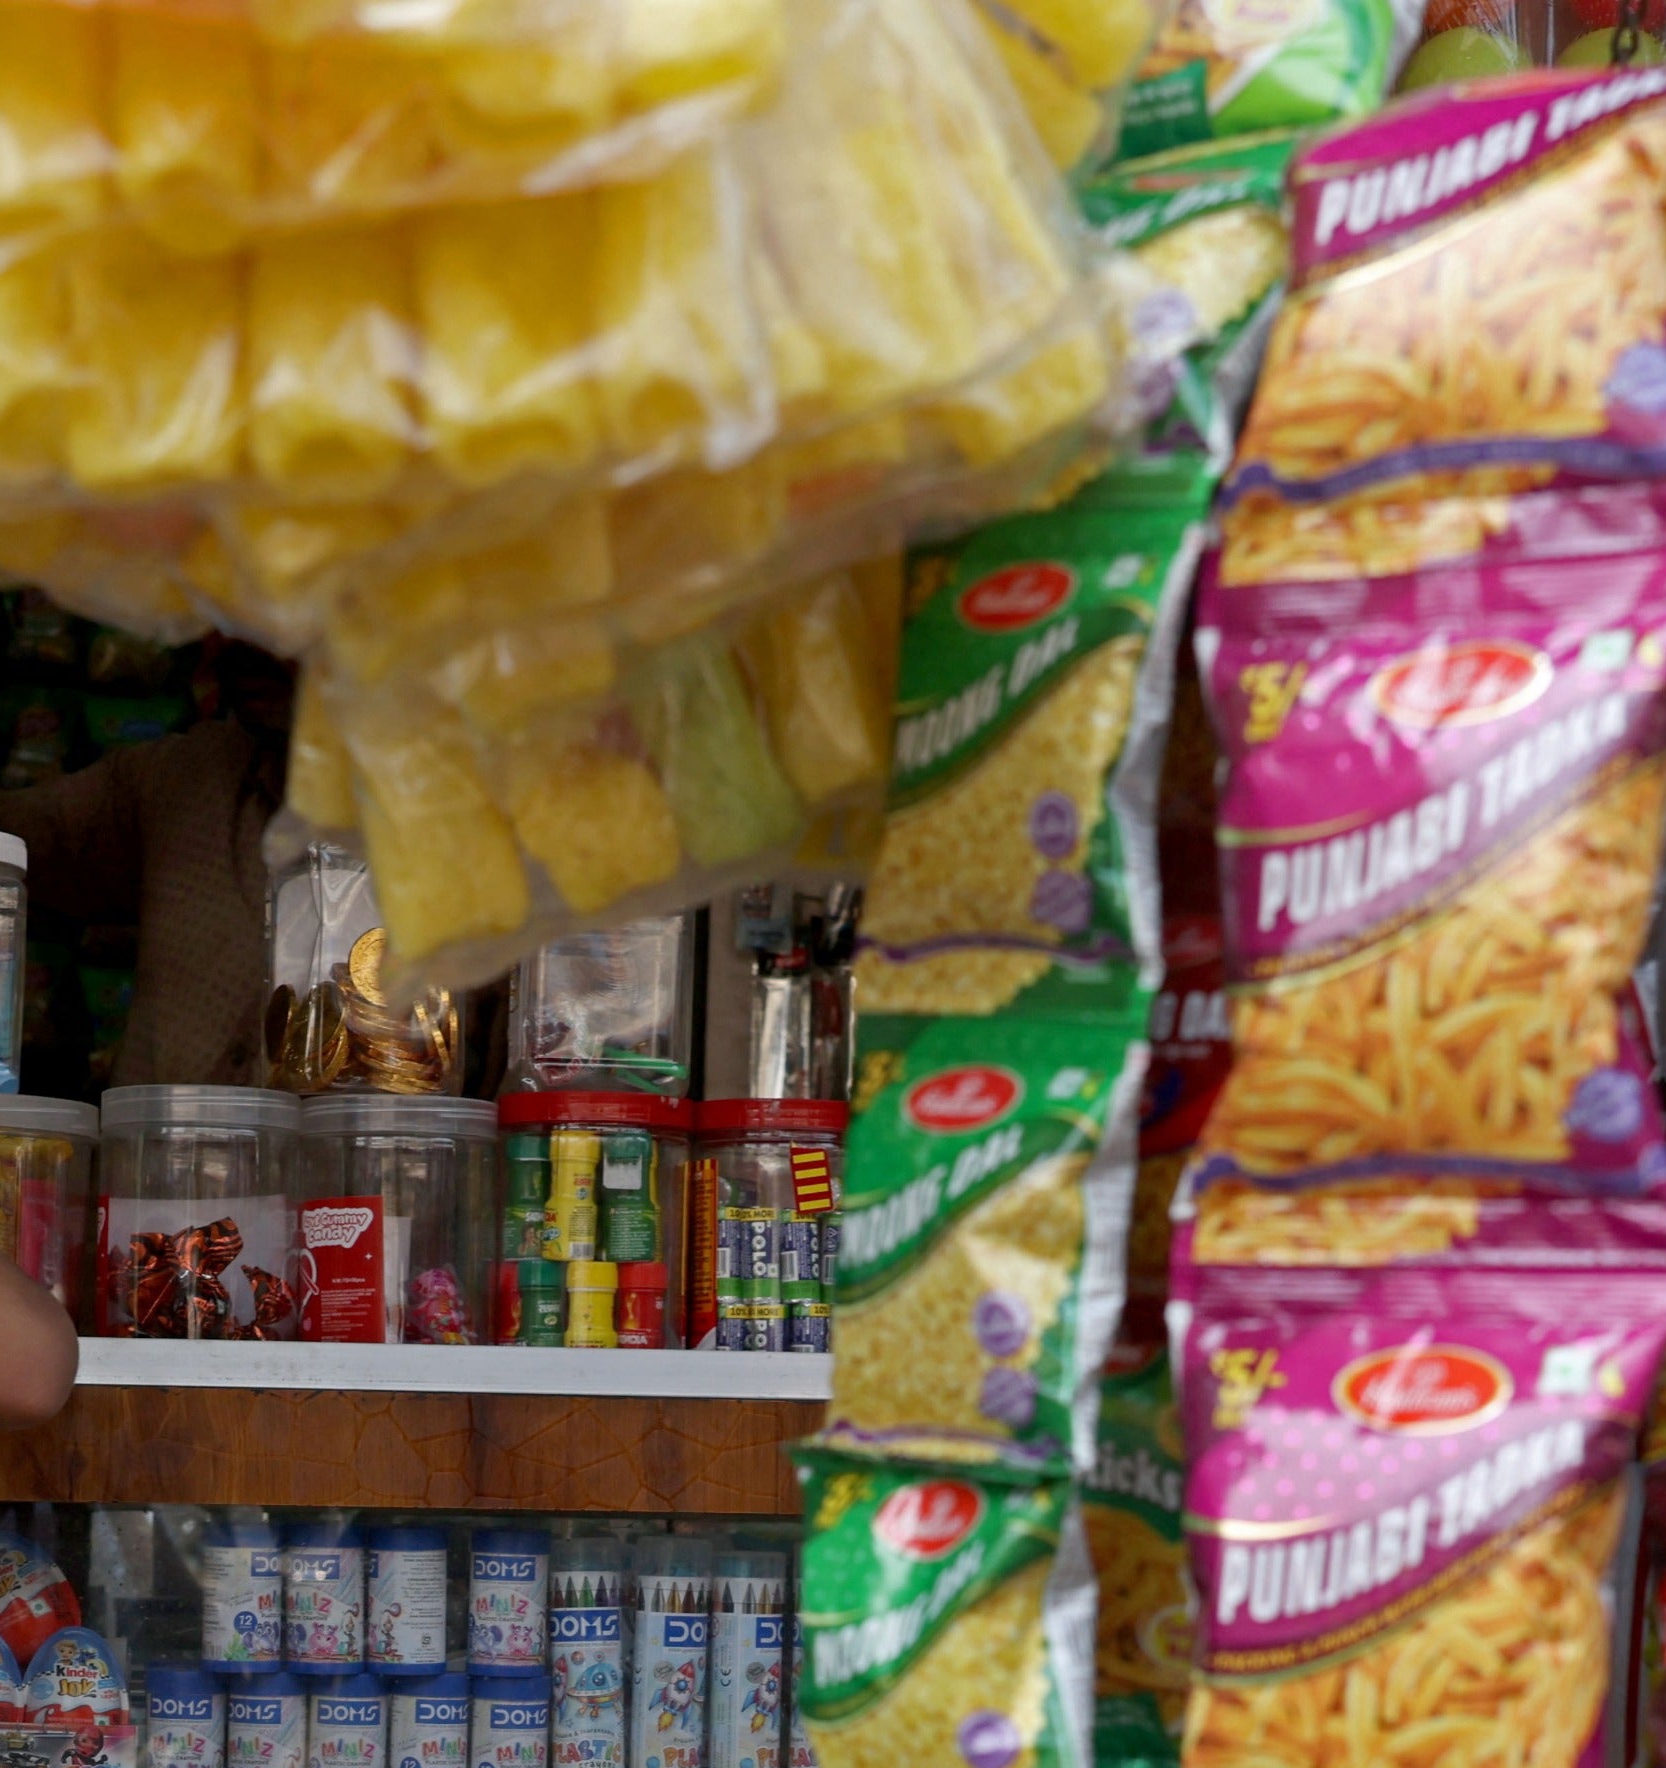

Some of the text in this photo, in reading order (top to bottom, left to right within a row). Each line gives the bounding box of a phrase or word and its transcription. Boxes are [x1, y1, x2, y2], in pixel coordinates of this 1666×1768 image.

[1260, 788, 1469, 932] PUNJABI
[752, 1222, 767, 1276] POLO
[475, 1560, 532, 1577] DOMS
[1216, 1521, 1428, 1626] PUNJABI
[239, 1615, 253, 1625] 12
[152, 1698, 209, 1717] DOMS
[319, 1703, 378, 1721] DOMS
